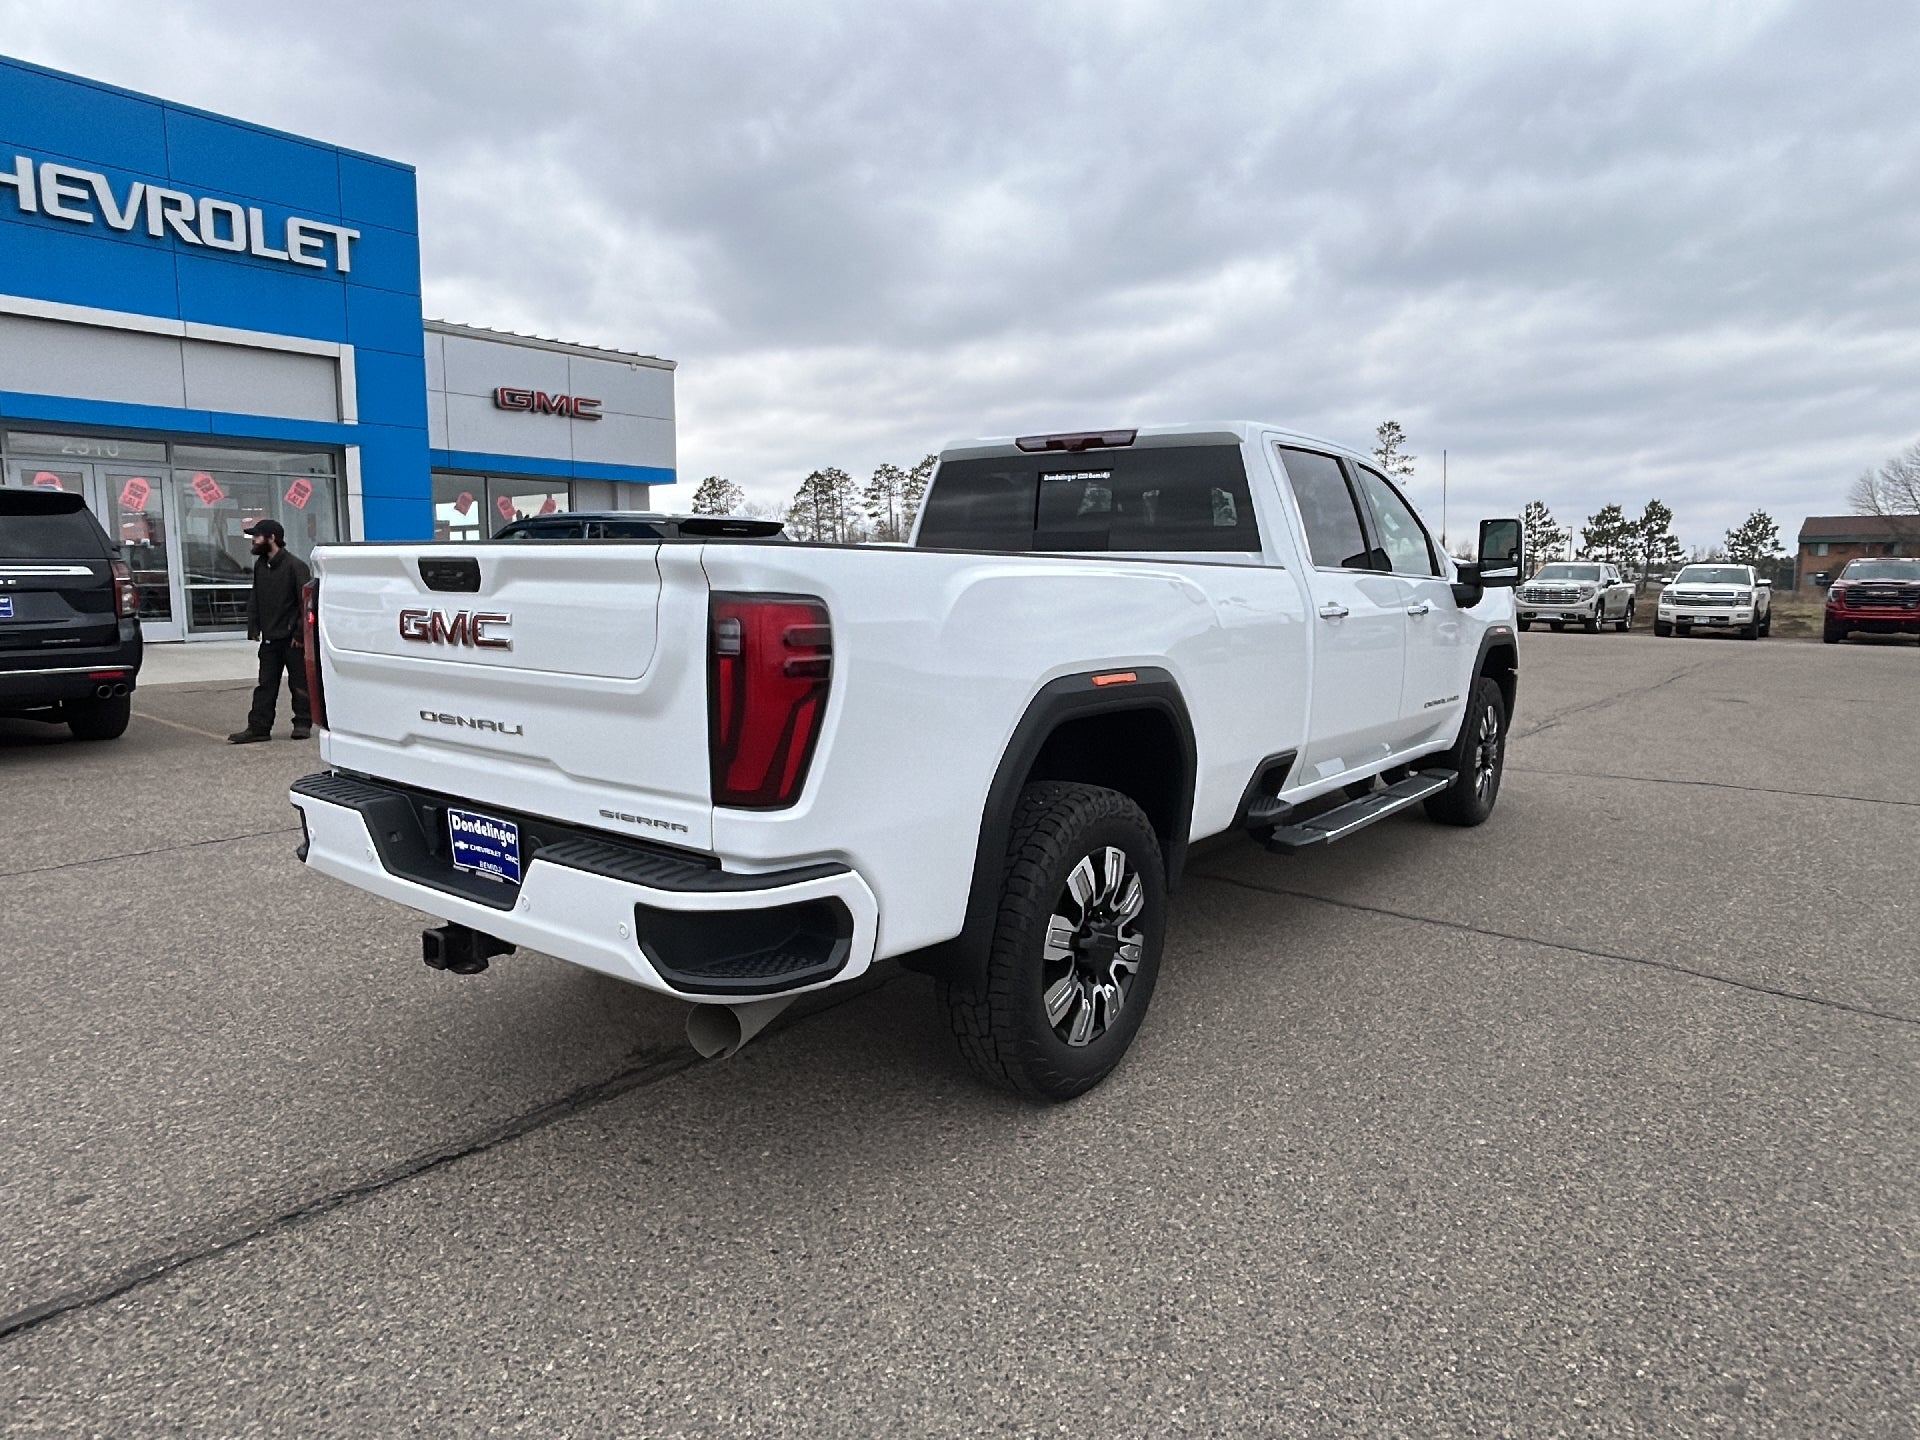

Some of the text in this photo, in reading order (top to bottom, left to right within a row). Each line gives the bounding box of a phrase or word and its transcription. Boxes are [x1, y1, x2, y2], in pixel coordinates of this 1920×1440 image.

[494, 387, 603, 421] GMC
[399, 607, 514, 653] GMC
[420, 710, 524, 736] DENALI
[451, 814, 516, 848] Dondelinger
[599, 809, 689, 833] SIERRA
[469, 844, 502, 858] CHEVROLET
